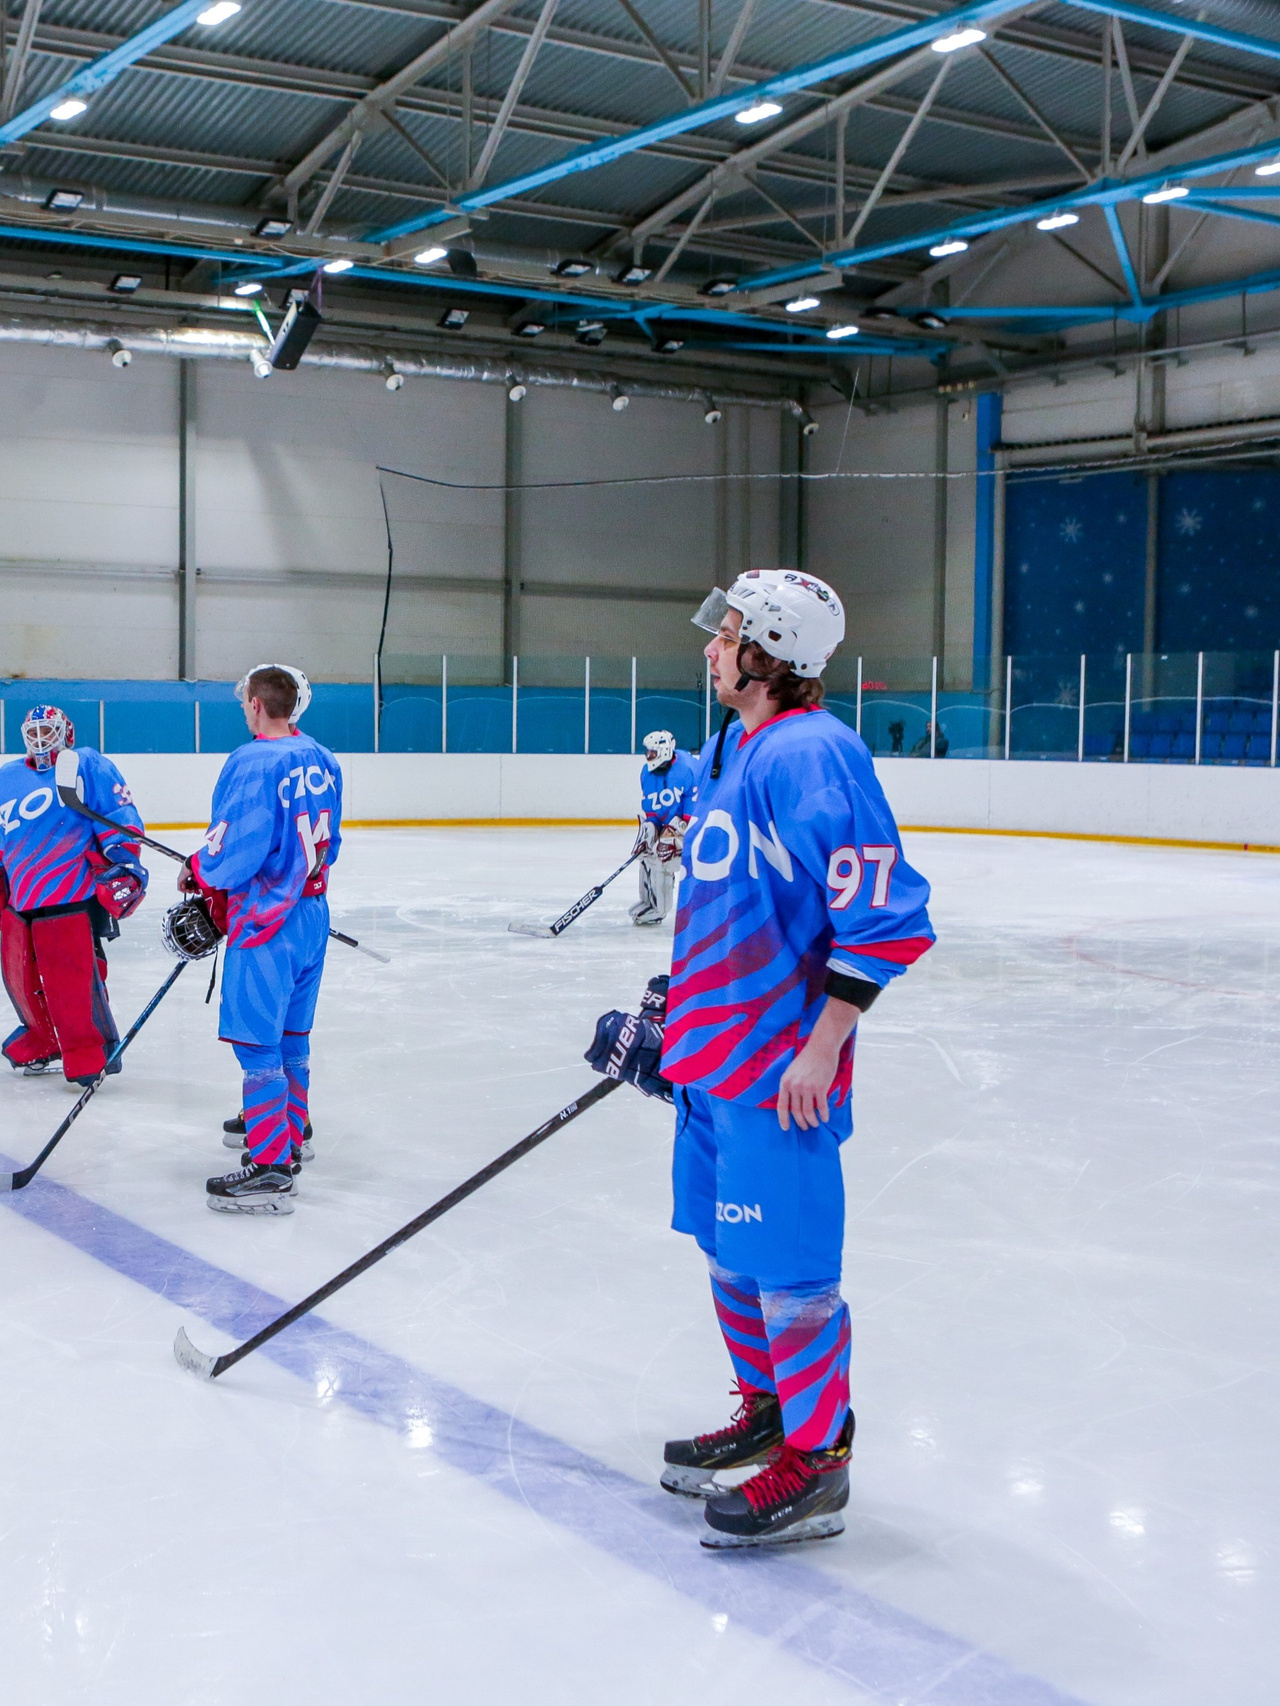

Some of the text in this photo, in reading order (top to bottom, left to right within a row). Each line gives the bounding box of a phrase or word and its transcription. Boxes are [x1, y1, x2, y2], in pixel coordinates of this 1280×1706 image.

[648, 786, 684, 811] ZON
[827, 844, 898, 911] 97
[554, 889, 598, 932] FISCHER
[606, 1014, 640, 1079] AUER
[715, 1202, 762, 1224] ZON
